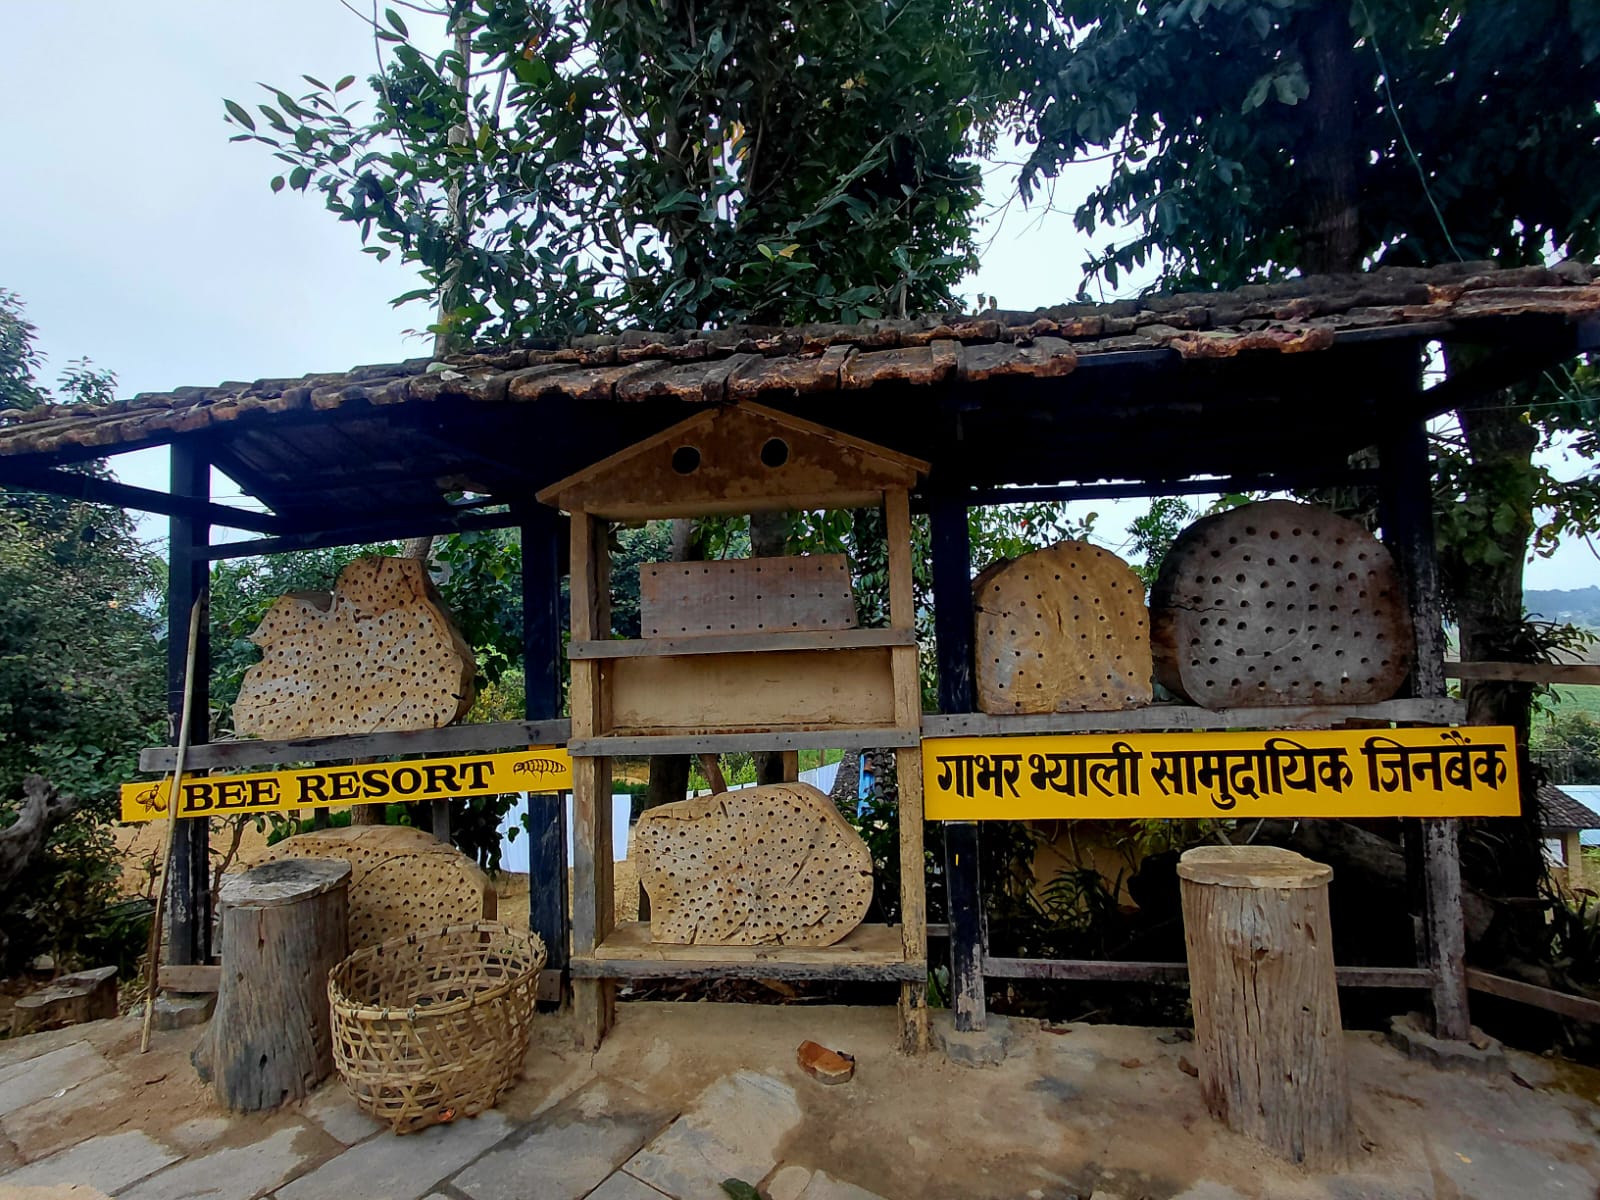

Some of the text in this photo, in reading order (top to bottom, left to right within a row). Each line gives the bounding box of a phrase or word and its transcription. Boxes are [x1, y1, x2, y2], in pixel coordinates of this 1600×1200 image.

[182, 760, 495, 812] BEE RESORT
[936, 730, 1507, 811] गाभर भ्याली सामुदायिक जिनबैंक
